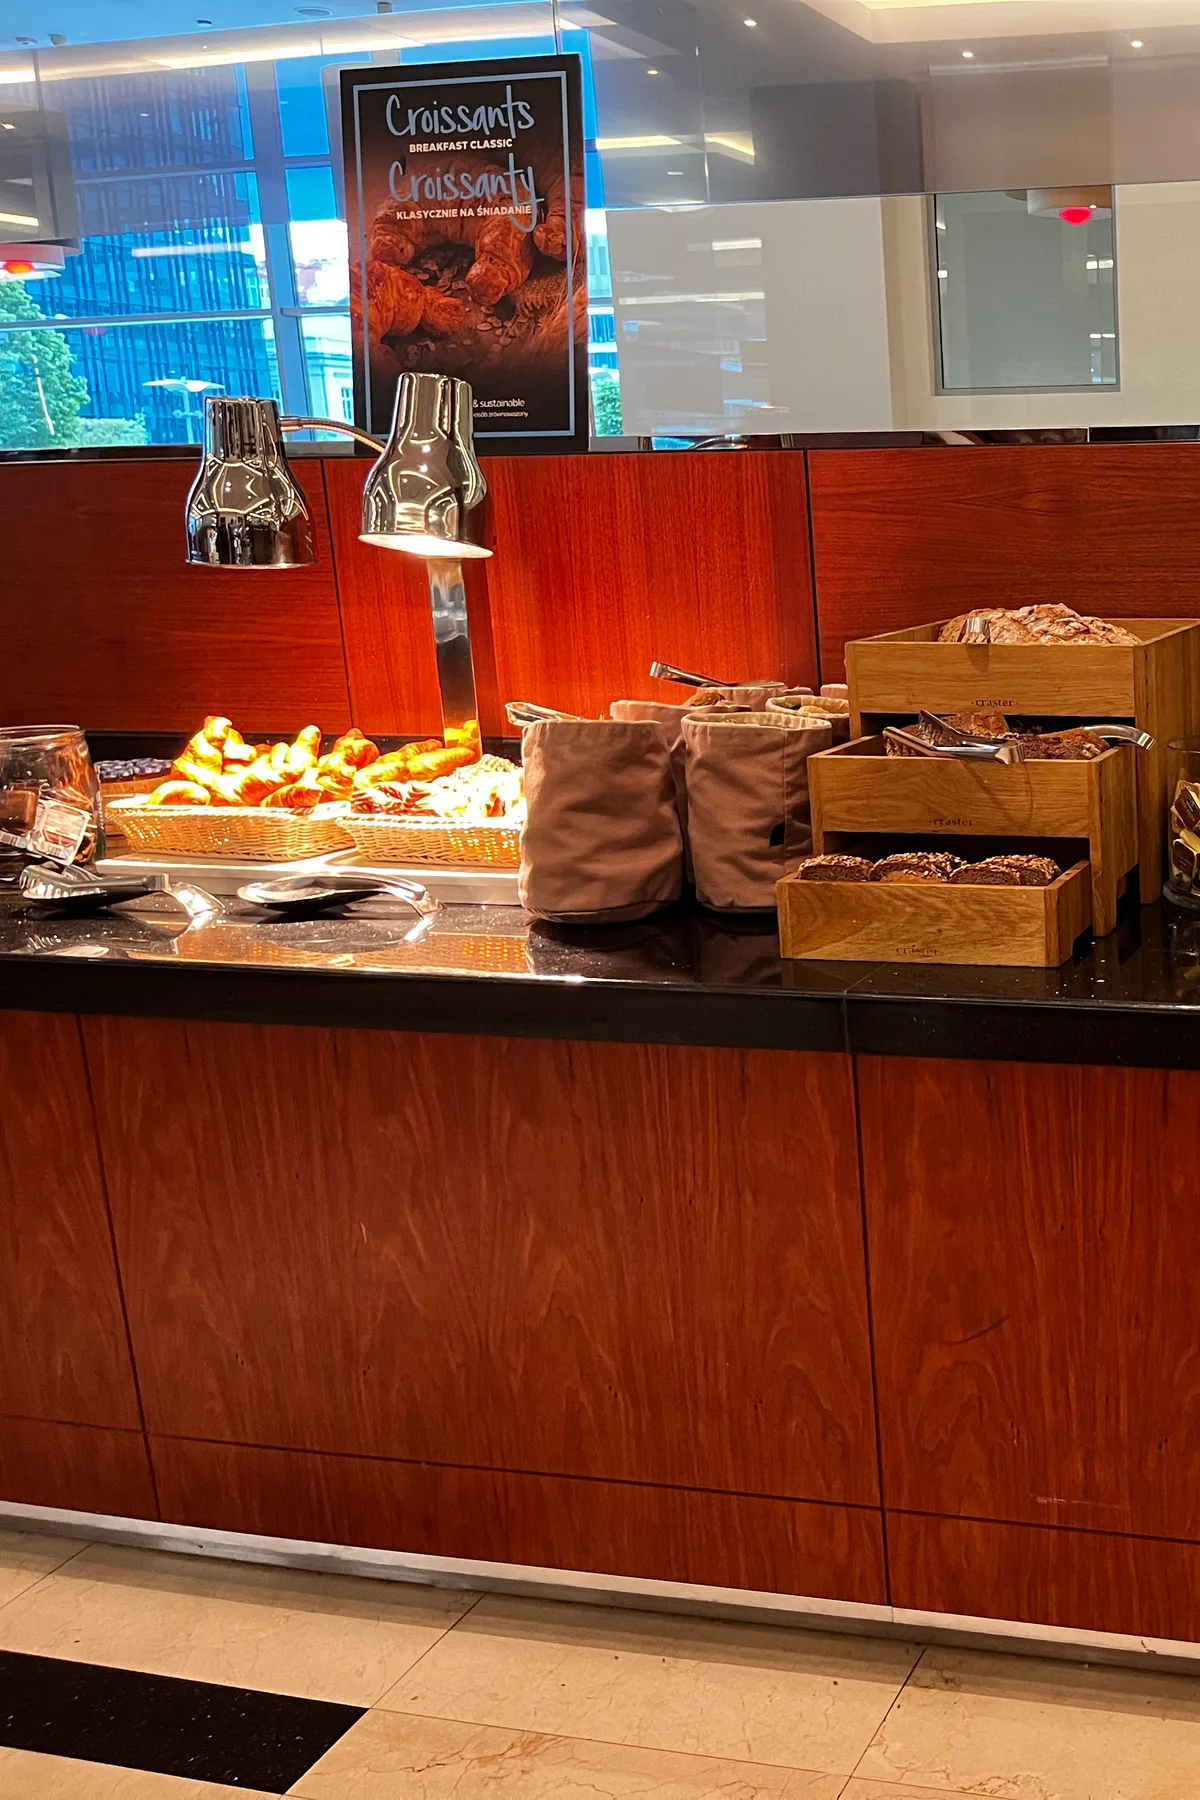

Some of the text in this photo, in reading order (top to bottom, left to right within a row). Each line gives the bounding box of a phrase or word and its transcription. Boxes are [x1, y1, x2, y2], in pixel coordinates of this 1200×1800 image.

[385, 84, 536, 139] Croissants
[409, 138, 513, 153] BREAKFAST CLASSIC
[388, 152, 545, 233] Croissanty
[396, 204, 532, 220] KLASYCZNIE NA ŚNIADANIE
[479, 398, 525, 407] sustainable
[975, 699, 1014, 707] craster
